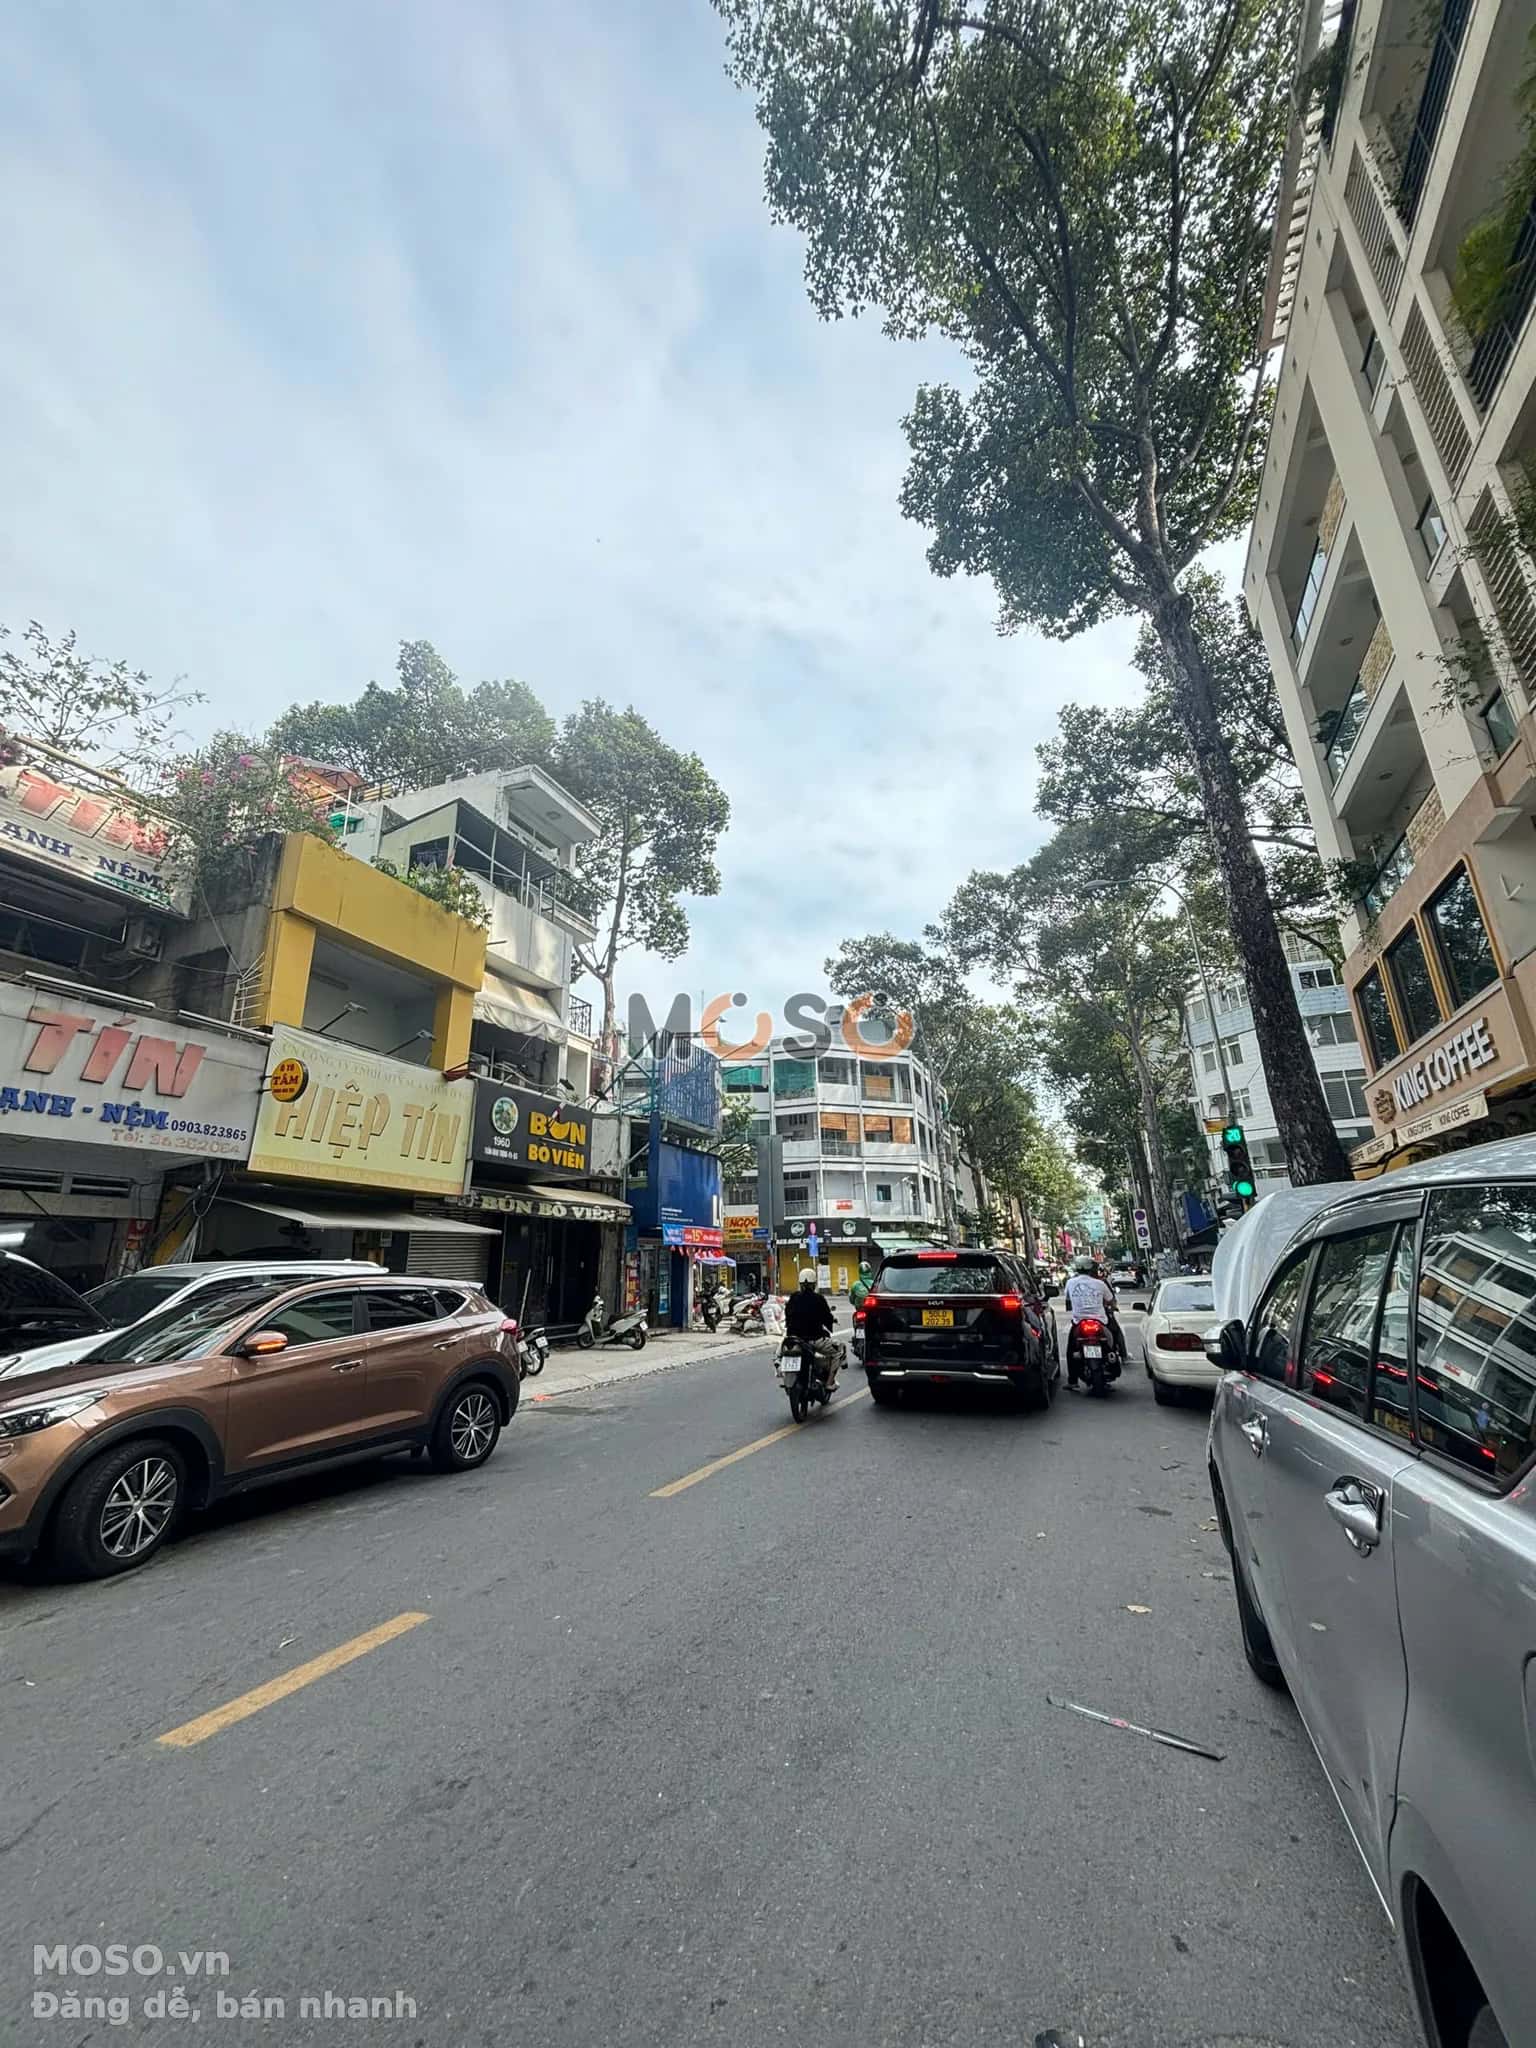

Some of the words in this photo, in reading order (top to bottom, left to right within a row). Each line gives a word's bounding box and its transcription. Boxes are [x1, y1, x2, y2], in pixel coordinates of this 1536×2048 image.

[24, 1006, 207, 1097] TÍN
[1392, 1062, 1430, 1110] KING
[1425, 1017, 1497, 1091] COFFEE
[400, 1103, 462, 1164] TÍN
[552, 1148, 585, 1169] VIÊN
